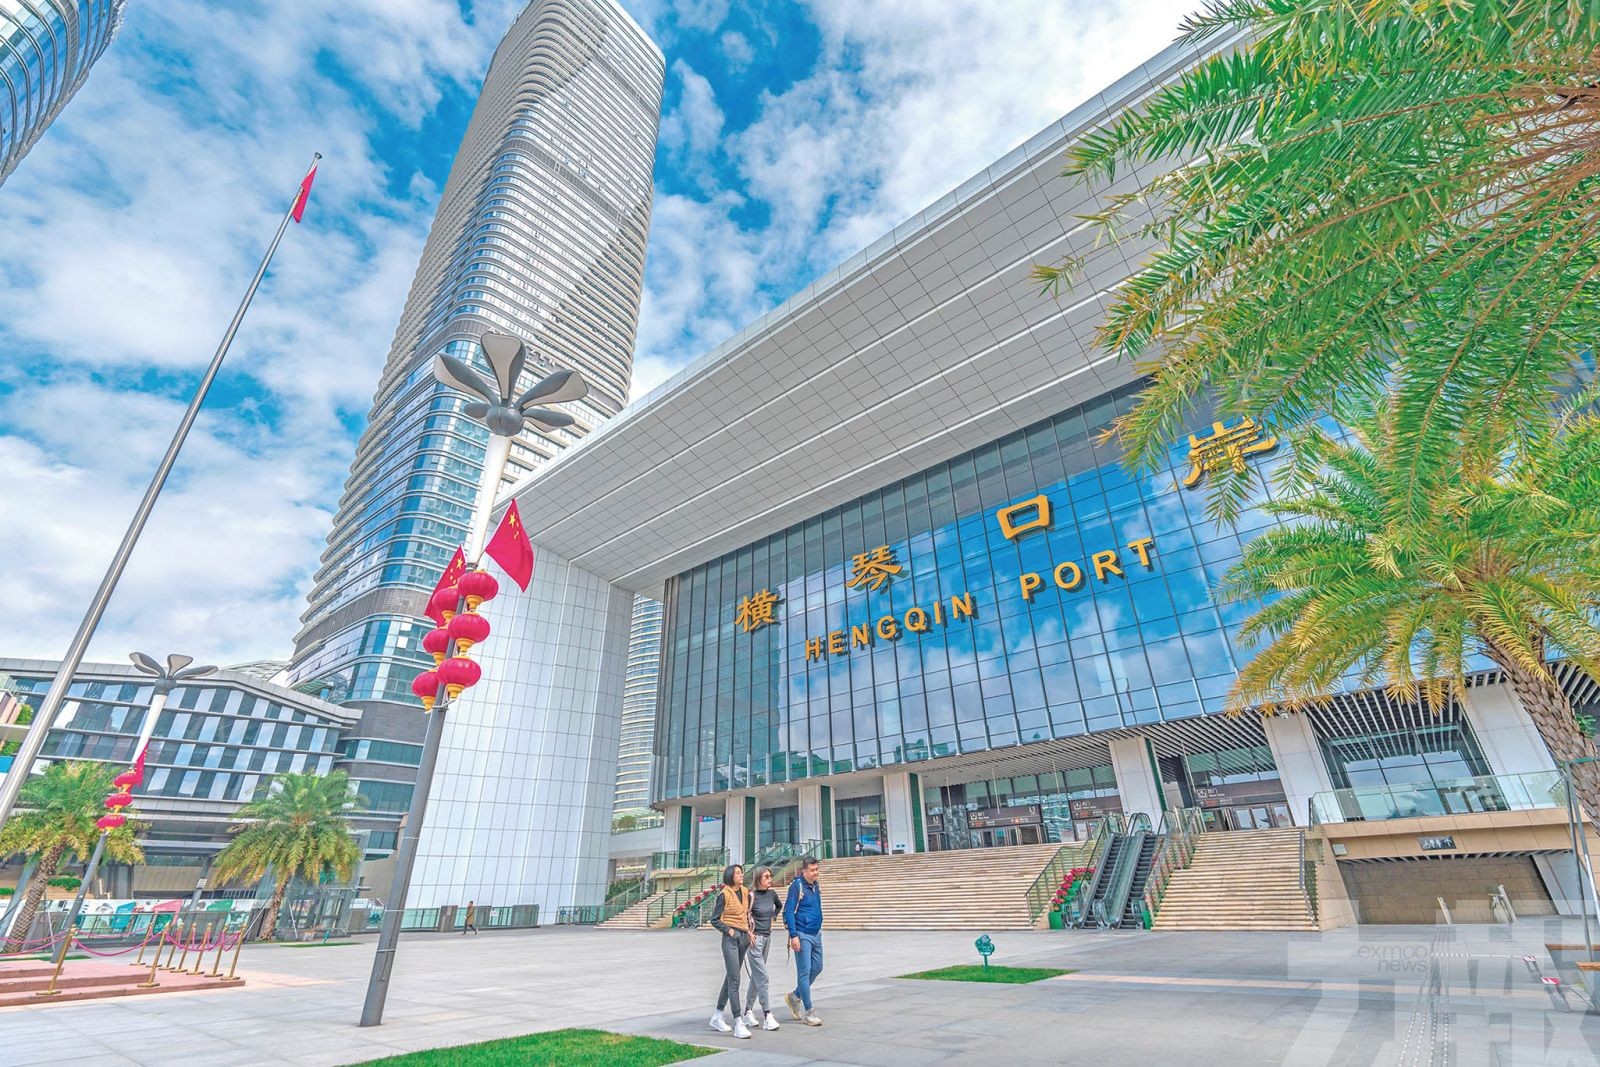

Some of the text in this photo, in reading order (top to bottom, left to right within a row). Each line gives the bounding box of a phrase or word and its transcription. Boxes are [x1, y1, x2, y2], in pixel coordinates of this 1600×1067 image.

[735, 415, 1277, 633] 横琴口岸
[805, 536, 1153, 661] HENGQIN PORT
